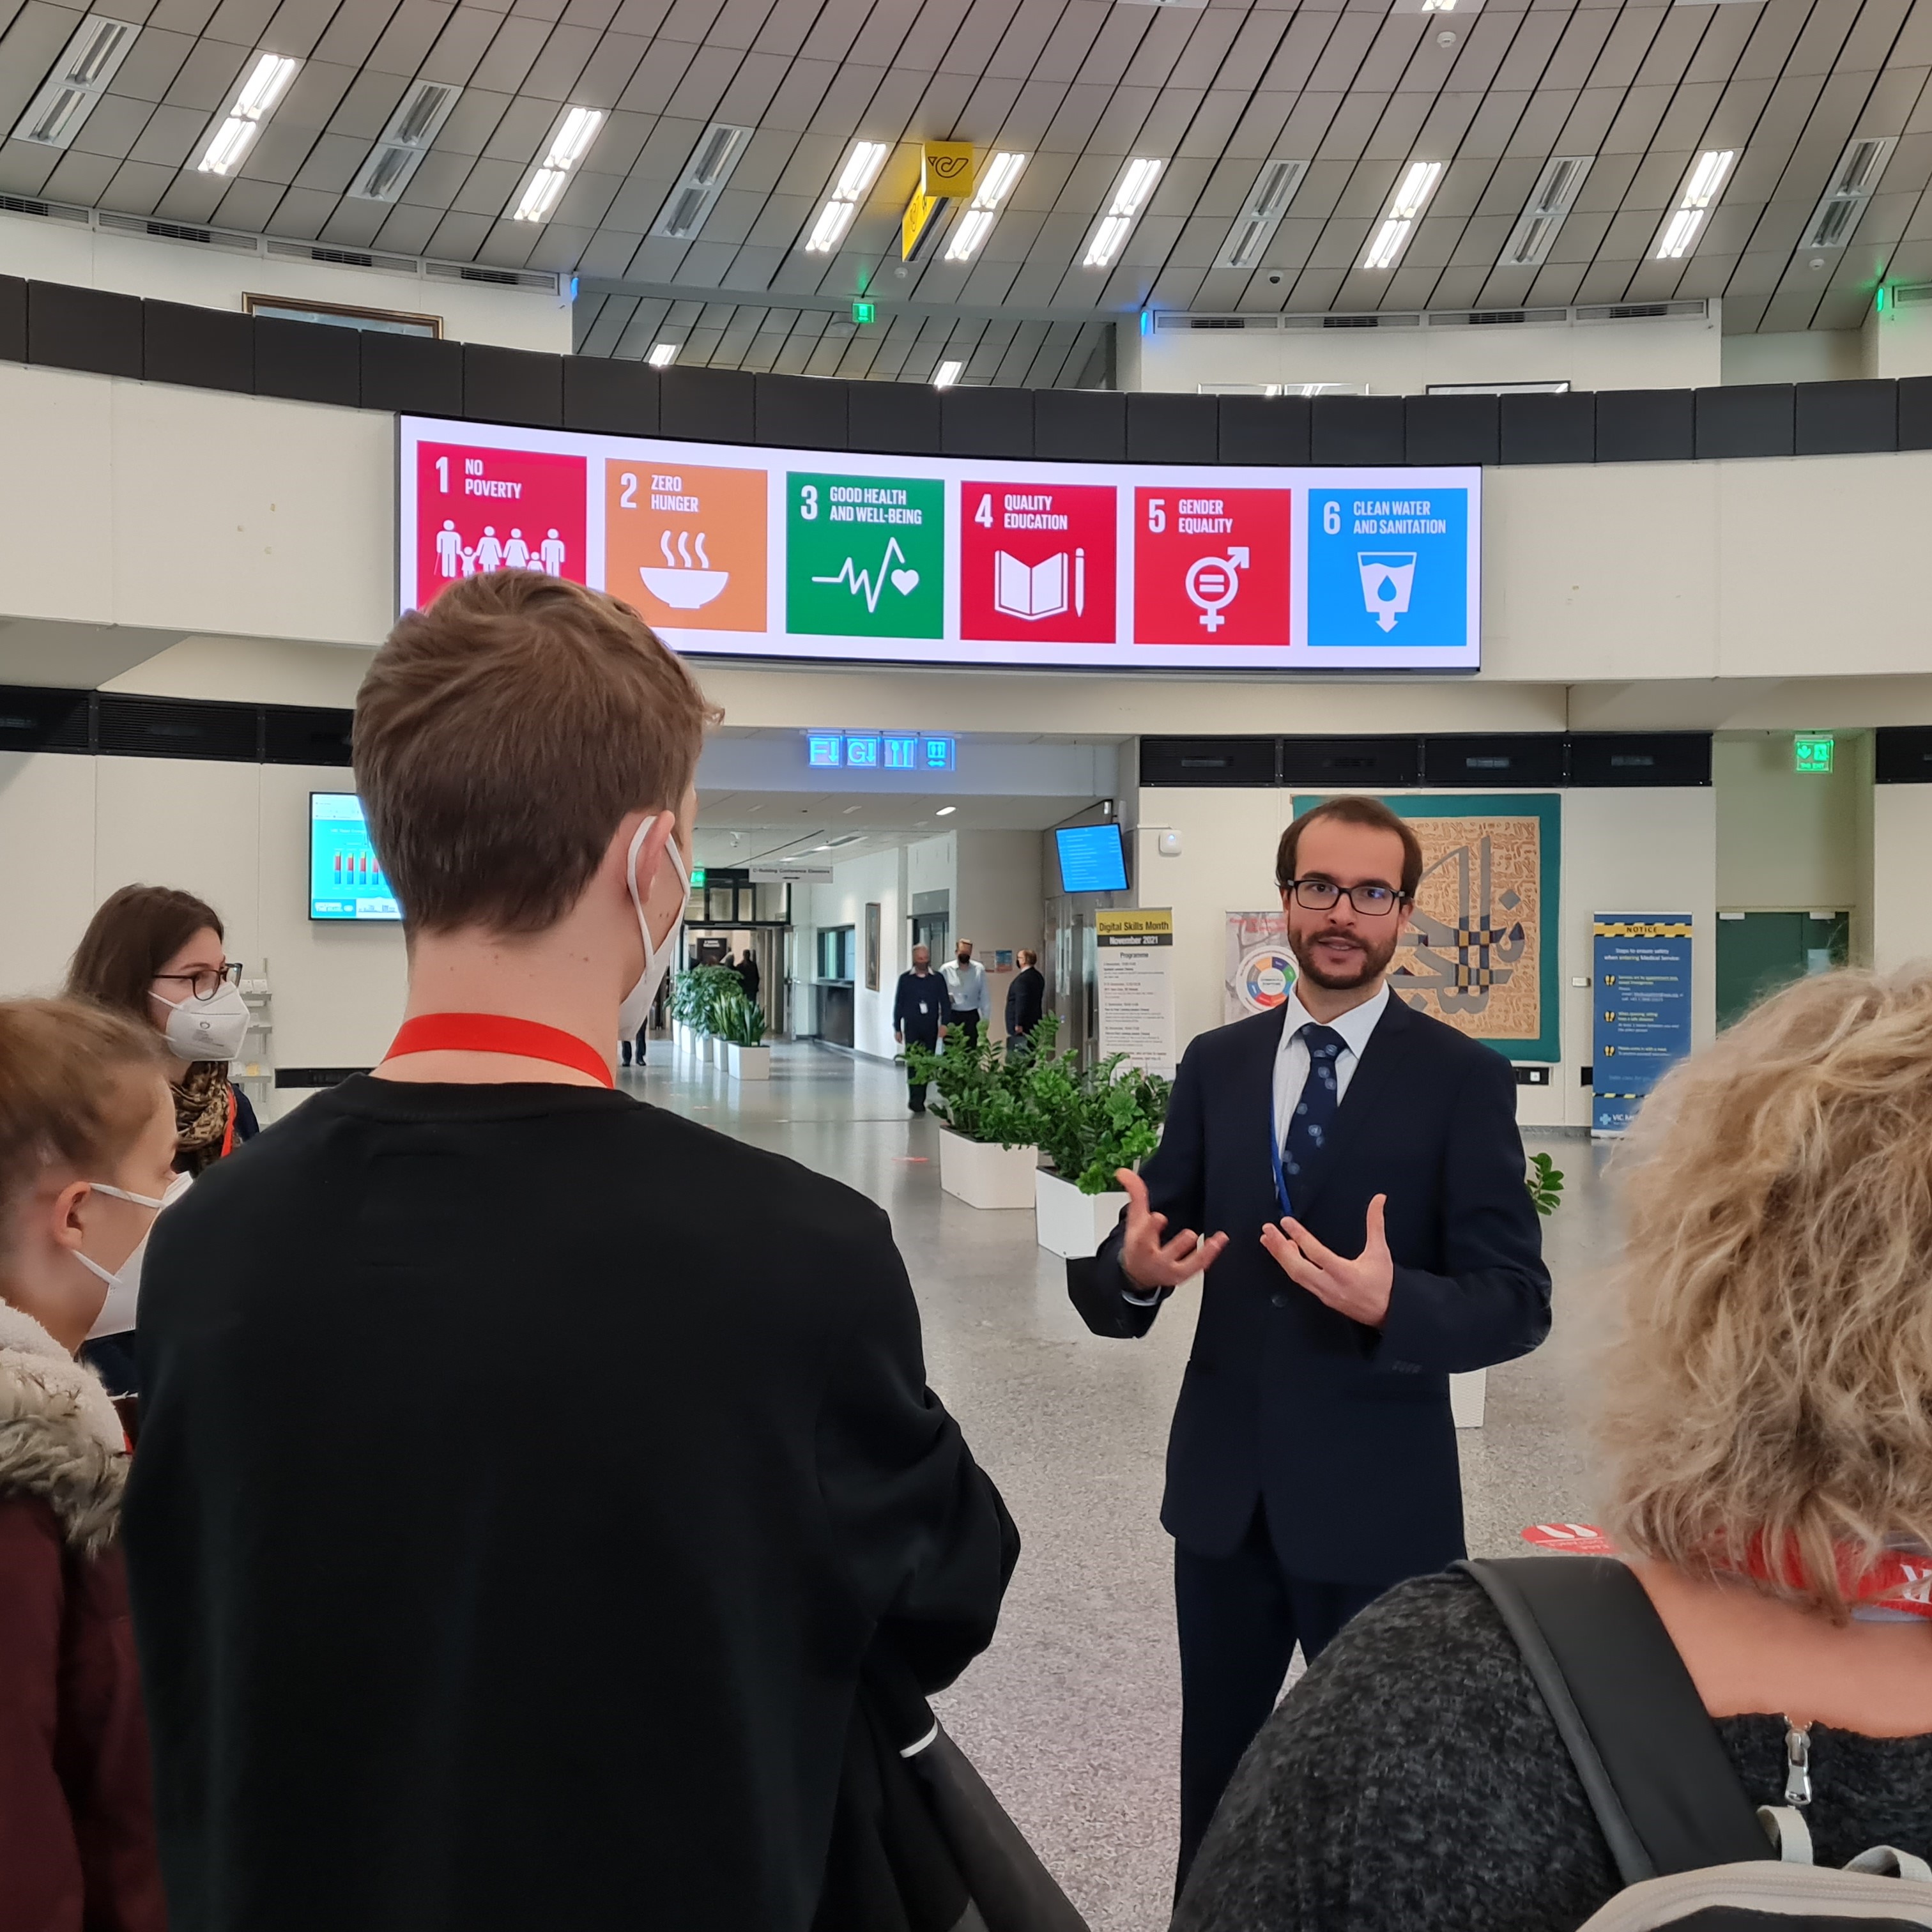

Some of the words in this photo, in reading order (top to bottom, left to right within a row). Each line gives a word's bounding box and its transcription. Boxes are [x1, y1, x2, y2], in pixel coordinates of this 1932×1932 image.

[436, 456, 448, 493] 1
[465, 458, 483, 476] NO
[465, 478, 521, 500] POVERTY
[620, 472, 638, 509] 2
[651, 474, 682, 492] ZERO
[651, 494, 699, 513] HUNGER
[801, 485, 818, 520] 3
[830, 486, 863, 503] GOOD
[863, 488, 907, 505] HEALTH
[1004, 494, 1052, 512] QUALITY
[829, 505, 855, 521] AND
[855, 507, 922, 525] WELL-BEING
[974, 494, 993, 528] 4
[1148, 498, 1166, 533] 5
[1179, 499, 1223, 515] GENDER
[1353, 501, 1391, 516] CLEAN
[1392, 501, 1430, 516] WATER
[1004, 512, 1068, 530] EDUCATION
[1178, 518, 1233, 535] EQUALITY
[1323, 501, 1341, 535] 6
[1354, 519, 1377, 534] AND
[1379, 519, 1446, 534] SANITATION
[810, 741, 829, 763] F
[848, 742, 866, 763] G
[1099, 922, 1122, 933] Digital
[1124, 922, 1144, 930] Skills
[1146, 921, 1169, 930] Month
[1109, 936, 1142, 945] November
[1142, 935, 1158, 944] 2021
